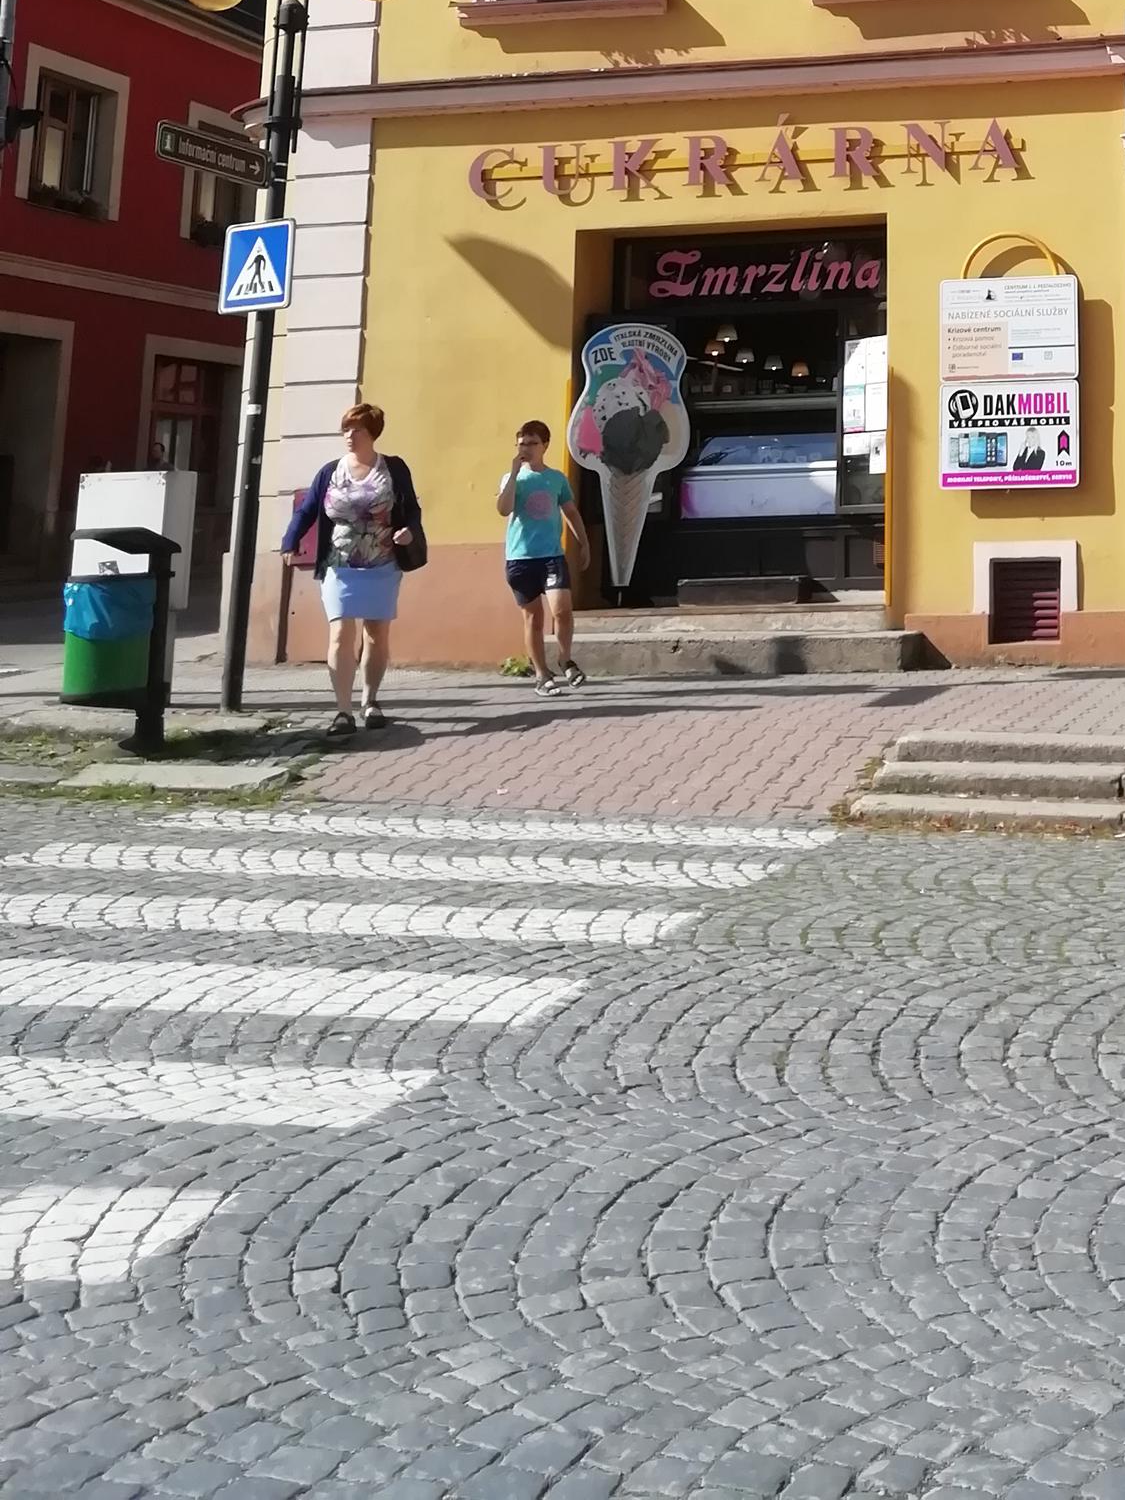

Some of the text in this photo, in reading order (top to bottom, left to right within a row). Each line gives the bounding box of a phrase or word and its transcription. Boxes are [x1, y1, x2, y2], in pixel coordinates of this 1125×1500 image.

[218, 153, 246, 172] centrum
[468, 113, 1019, 199] CUKRÁRNA
[649, 249, 881, 298] Zmrzlina
[947, 306, 1069, 320] NABÍZENÉ SOCIÁLNÍ SLUŽBY
[592, 347, 616, 364] ZDE
[983, 392, 1070, 416] DAKMOBIL
[953, 419, 972, 428] VŠE
[977, 419, 999, 427] PRO
[1030, 417, 1066, 426] MOBIL
